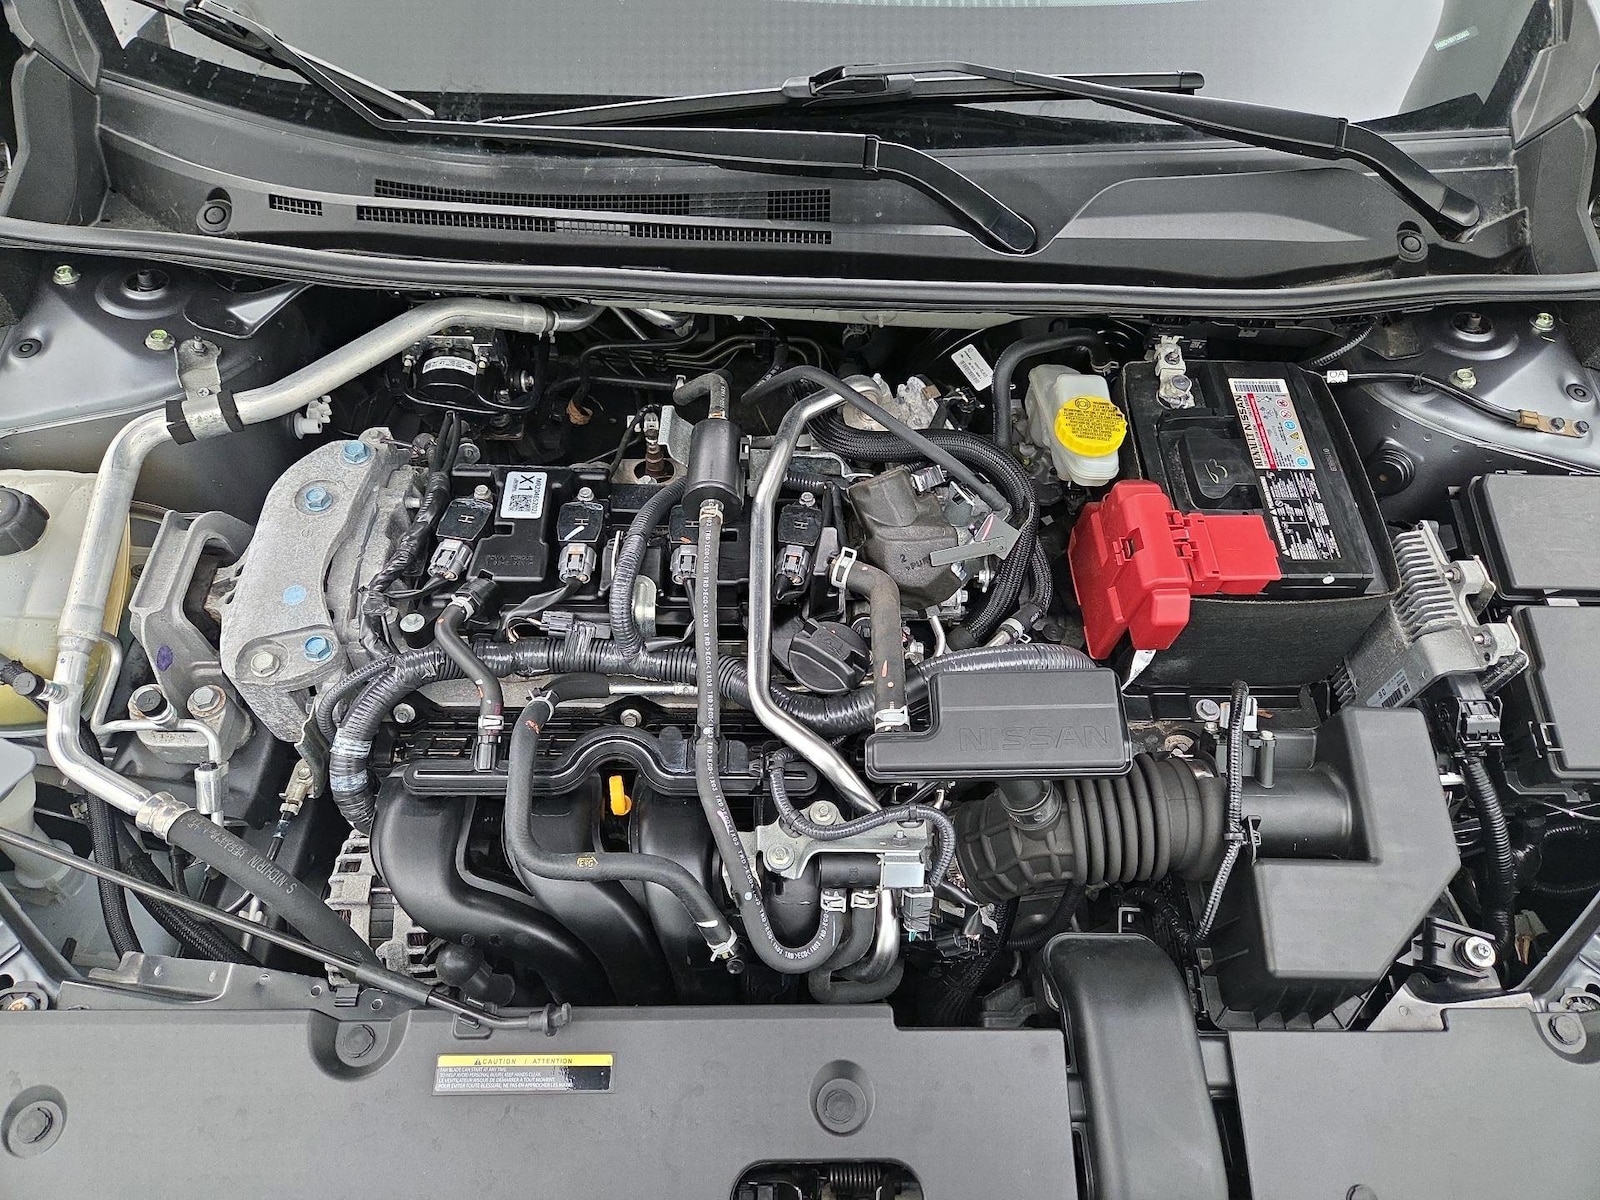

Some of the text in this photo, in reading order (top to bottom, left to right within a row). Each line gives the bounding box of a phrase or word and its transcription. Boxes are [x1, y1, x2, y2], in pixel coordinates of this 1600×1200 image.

[1234, 394, 1252, 431] NISSAN
[1246, 432, 1264, 467] RENAULT
[519, 474, 536, 490] X1
[958, 726, 1112, 752] NISSAN
